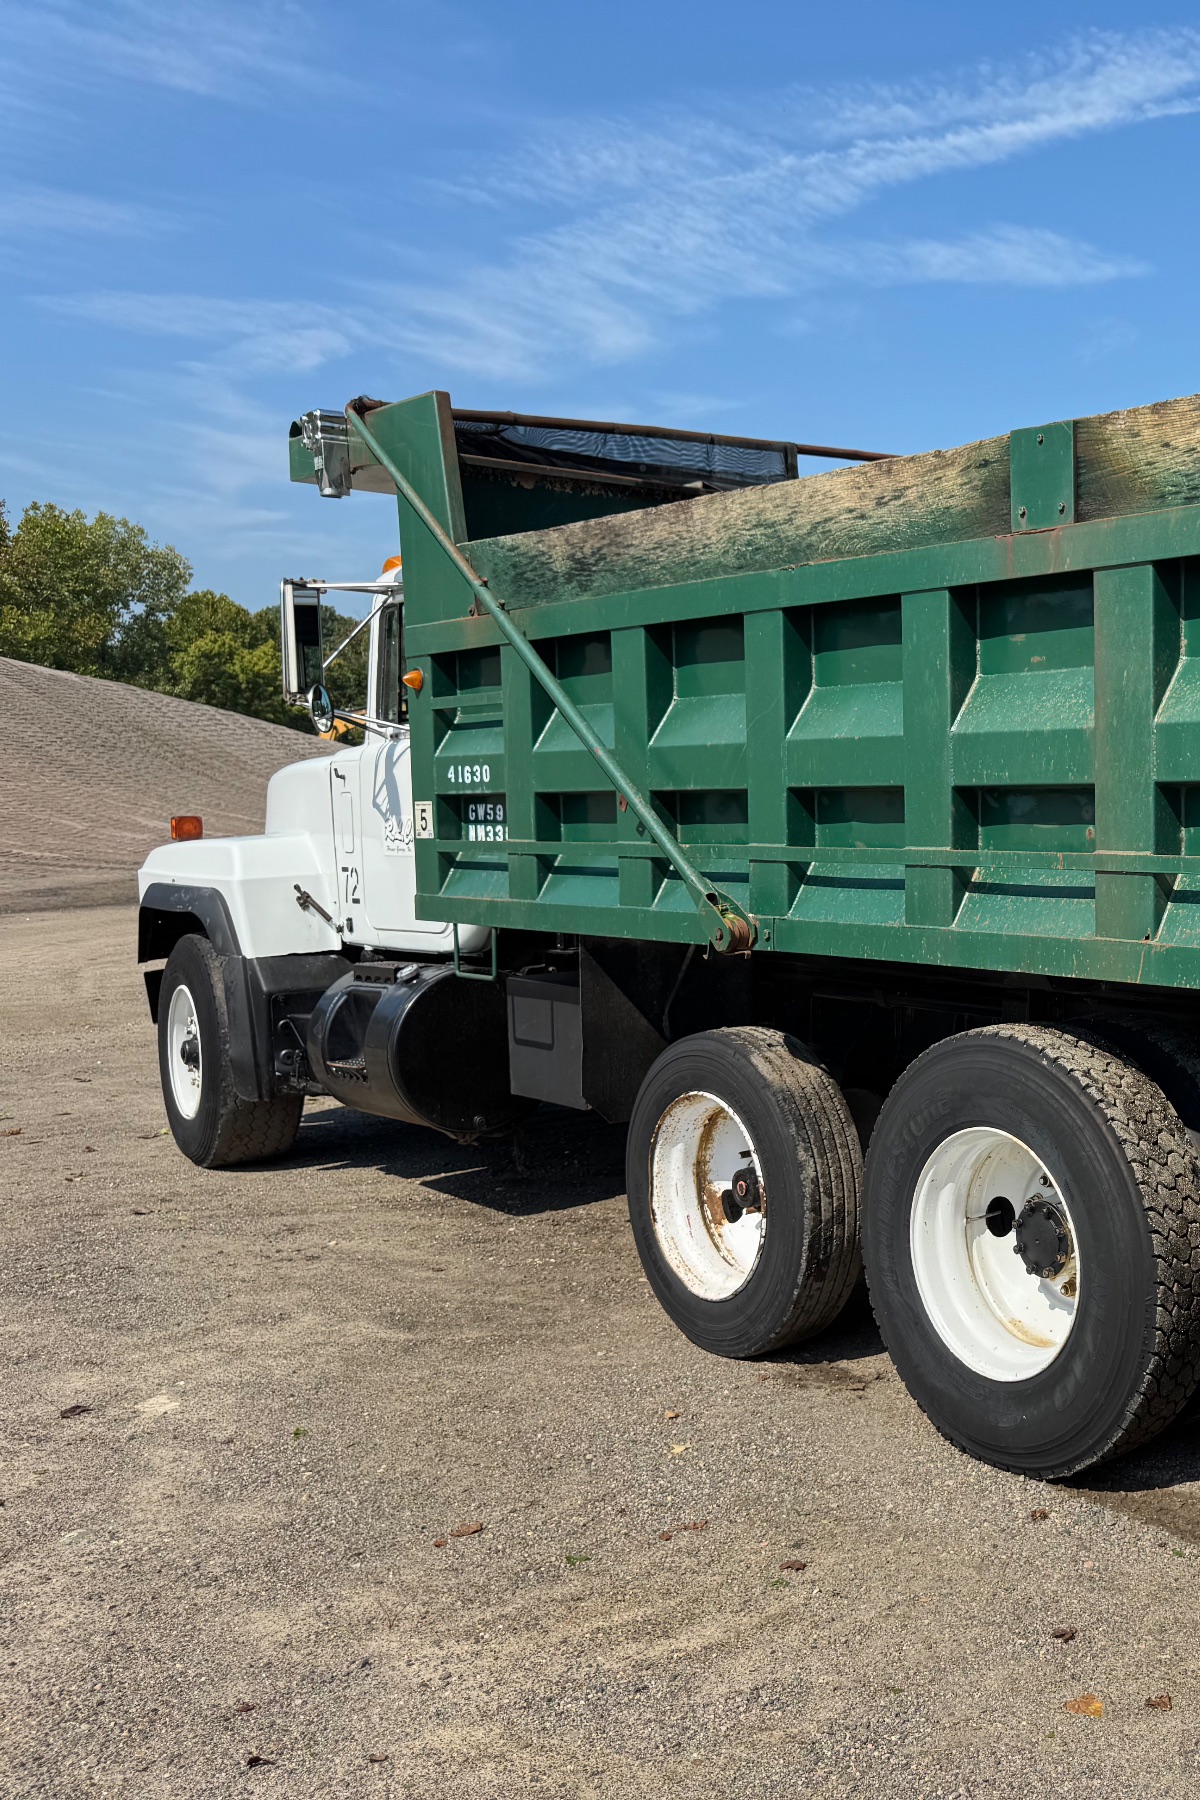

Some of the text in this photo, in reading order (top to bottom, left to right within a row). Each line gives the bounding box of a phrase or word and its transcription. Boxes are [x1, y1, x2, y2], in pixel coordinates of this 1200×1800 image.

[447, 765, 490, 784] 41630
[420, 808, 428, 832] 5
[468, 803, 504, 821] GW59
[468, 824, 508, 842] NM33
[341, 866, 361, 904] 72
